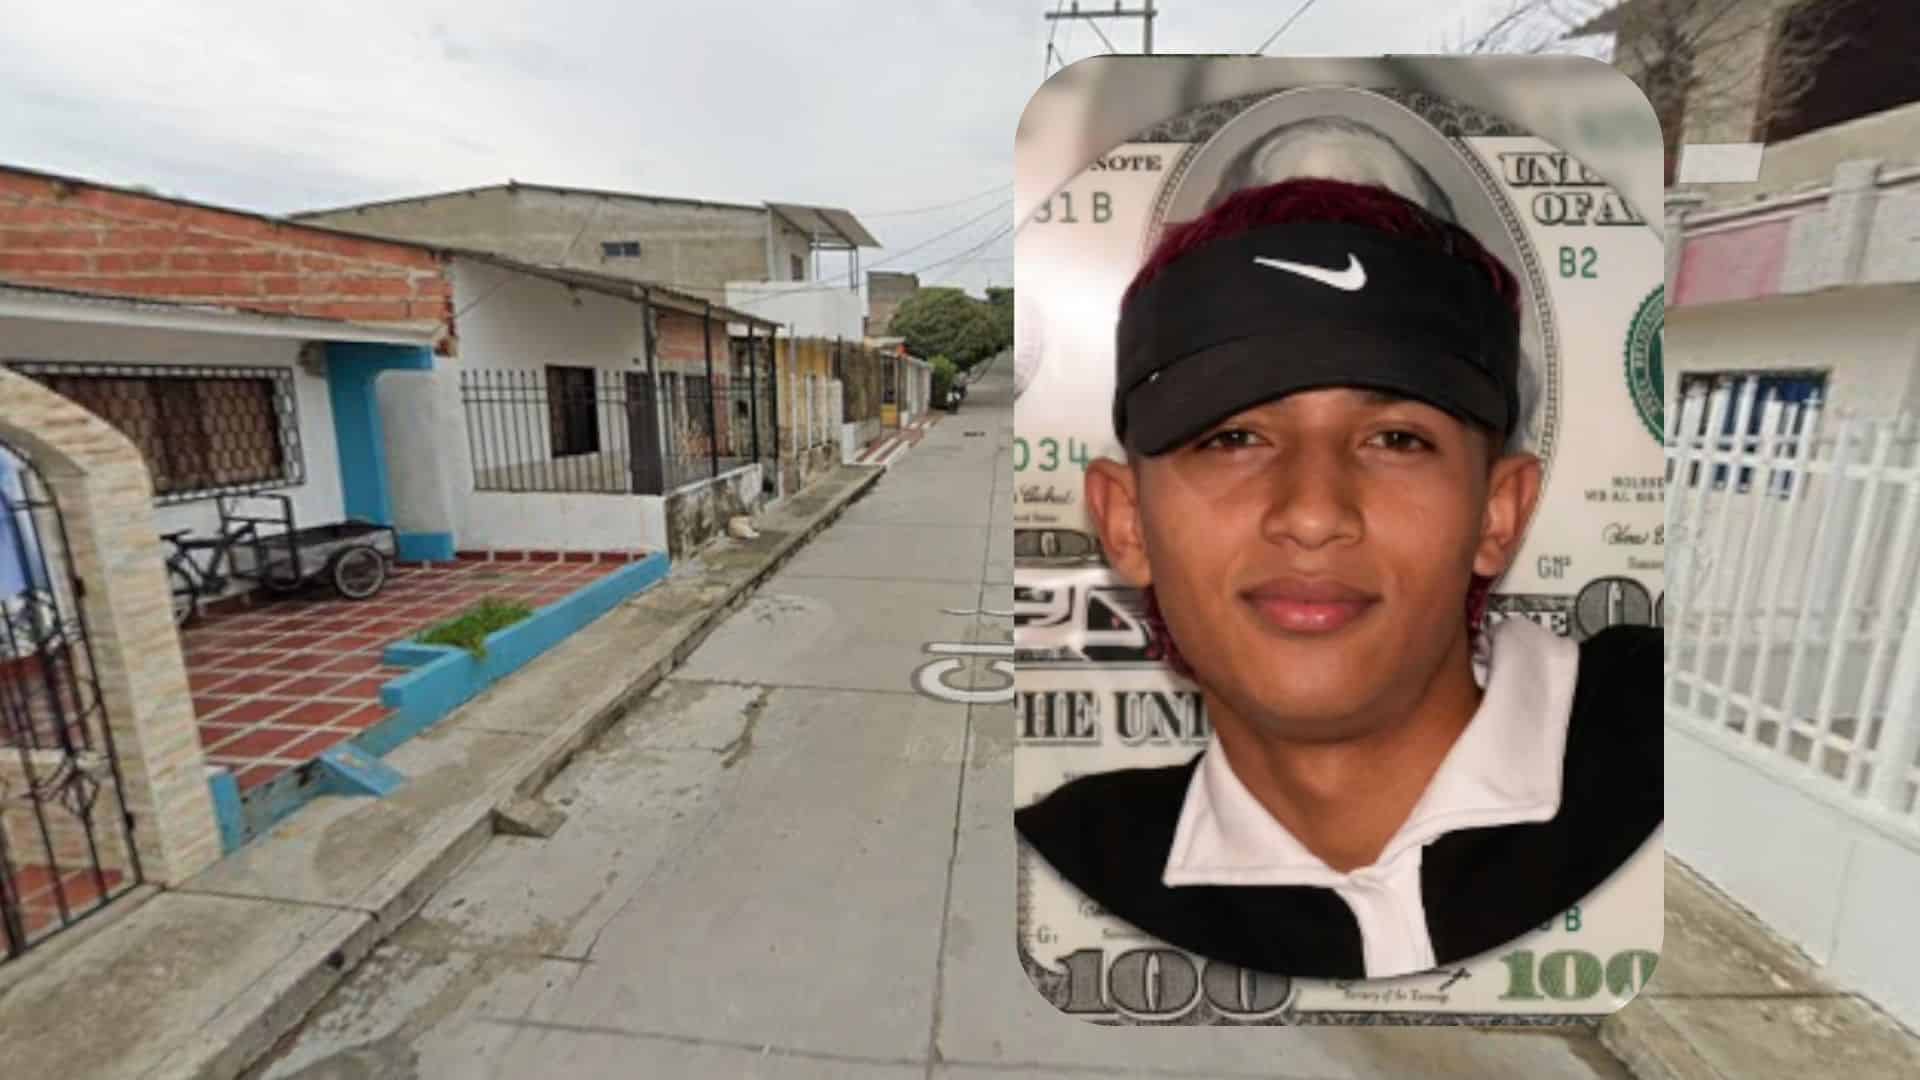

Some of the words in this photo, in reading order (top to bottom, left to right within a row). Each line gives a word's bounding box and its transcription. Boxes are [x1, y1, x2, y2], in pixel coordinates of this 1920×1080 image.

[1089, 155, 1163, 172] NOTE
[1092, 191, 1113, 224] B
[1533, 192, 1593, 227] OF
[1559, 246, 1599, 279] B2
[1014, 690, 1102, 746] HE
[1052, 947, 1292, 1020] 100
[1498, 949, 1659, 1001] 100
